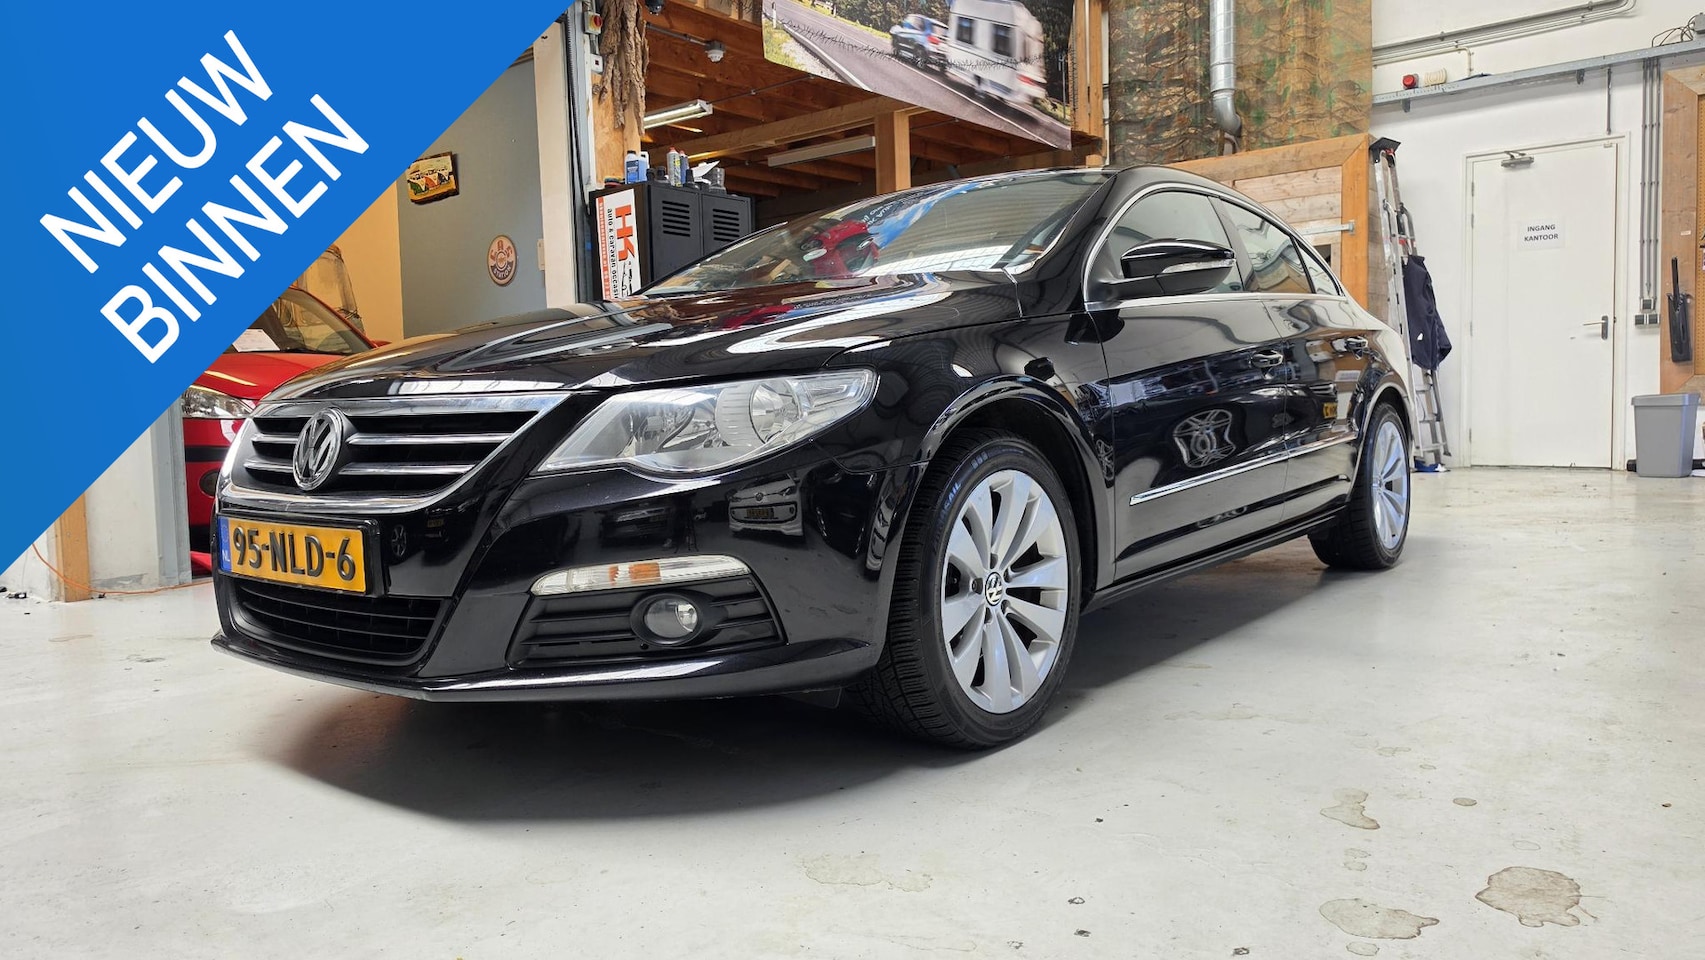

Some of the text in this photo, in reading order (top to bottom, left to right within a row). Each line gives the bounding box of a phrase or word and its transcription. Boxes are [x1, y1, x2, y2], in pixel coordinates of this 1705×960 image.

[615, 204, 635, 261] HK
[1527, 224, 1556, 232] INGANG
[1523, 233, 1559, 241] KANTOOR
[493, 264, 512, 279] STATION
[221, 549, 231, 562] NL
[232, 526, 356, 581] 95-NLD-6
